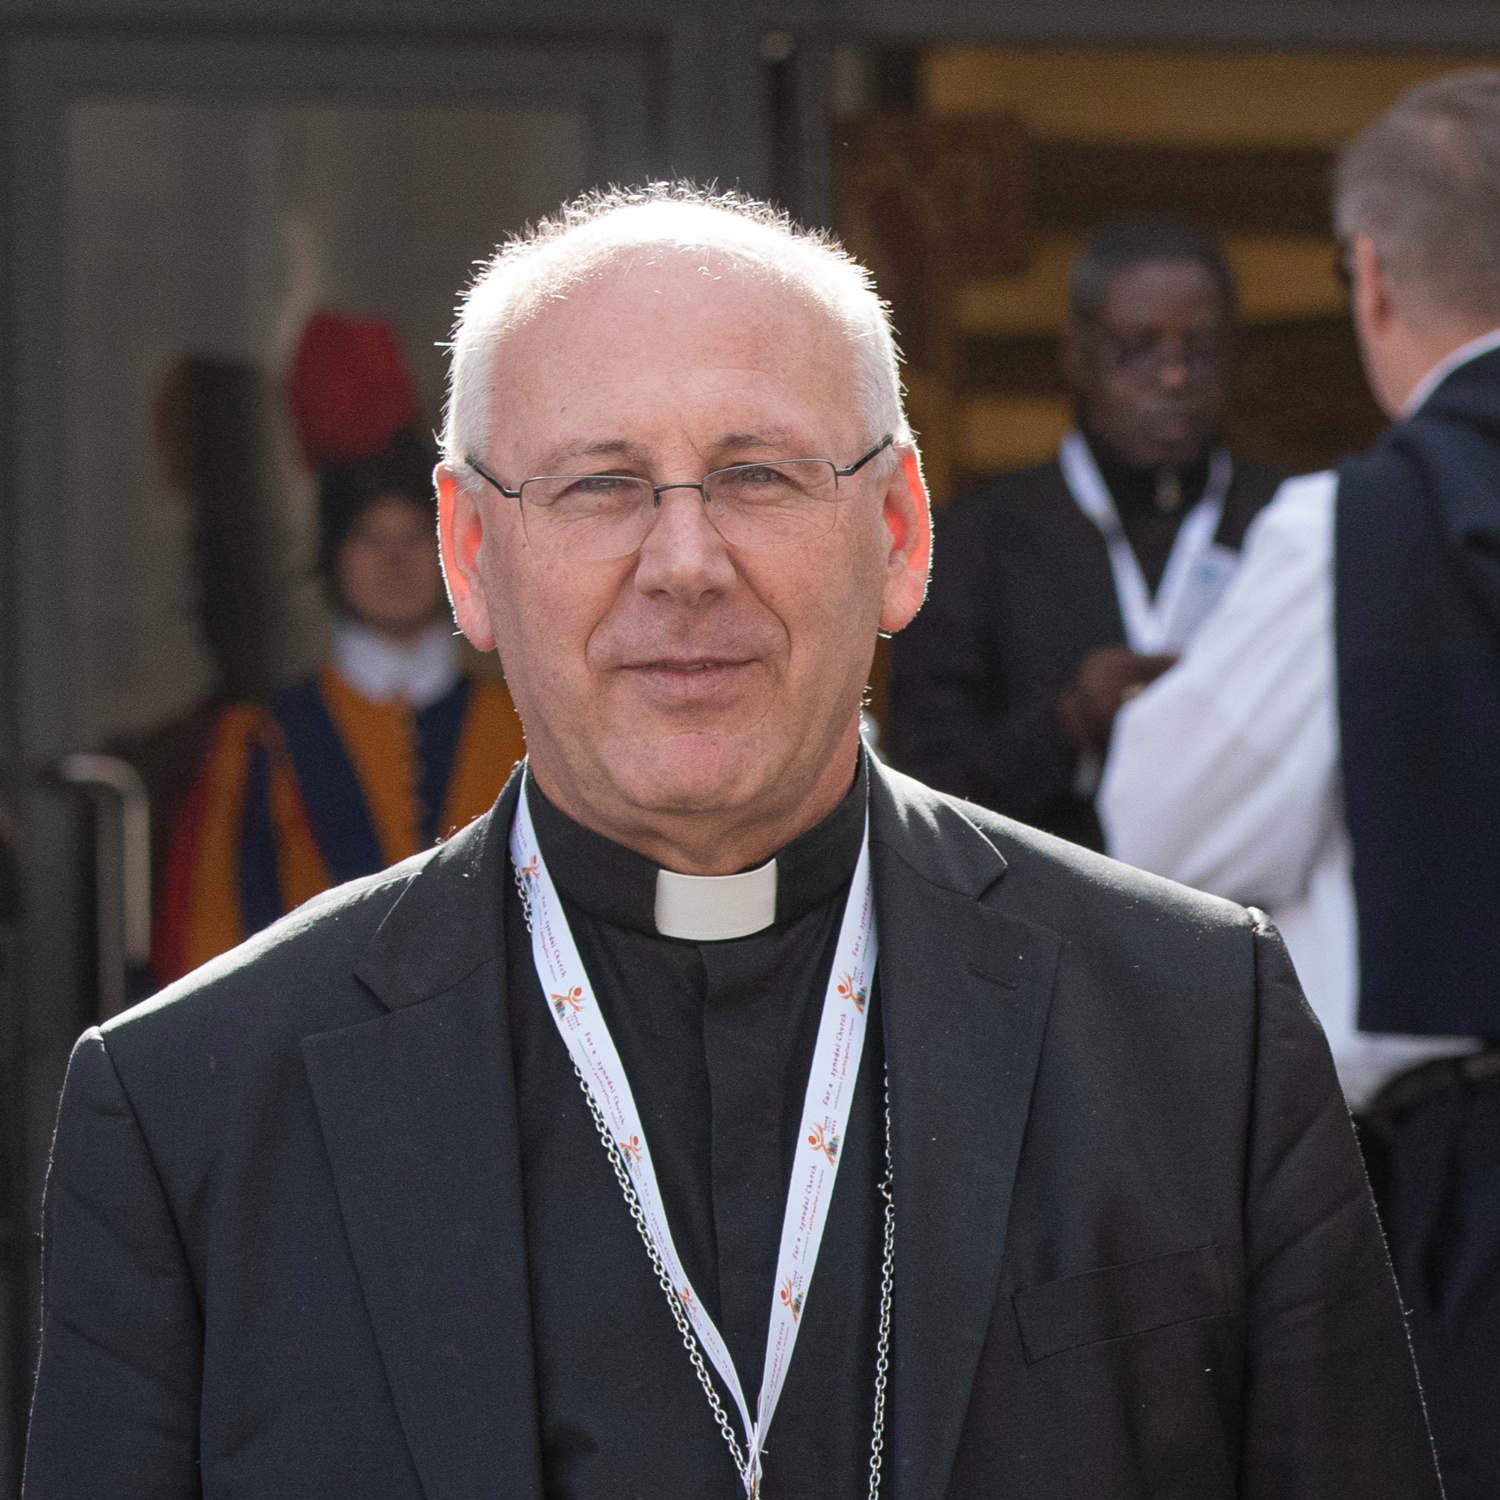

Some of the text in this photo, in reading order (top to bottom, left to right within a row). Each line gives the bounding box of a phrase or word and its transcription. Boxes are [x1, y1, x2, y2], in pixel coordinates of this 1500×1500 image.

[851, 942, 860, 957] For
[835, 1013, 848, 1041] Church
[584, 1032, 594, 1046] For
[829, 1043, 843, 1077] synodal
[822, 1091, 831, 1105] For
[792, 1245, 800, 1259] For
[798, 1196, 811, 1231] synodal
[805, 1165, 817, 1194] Church
